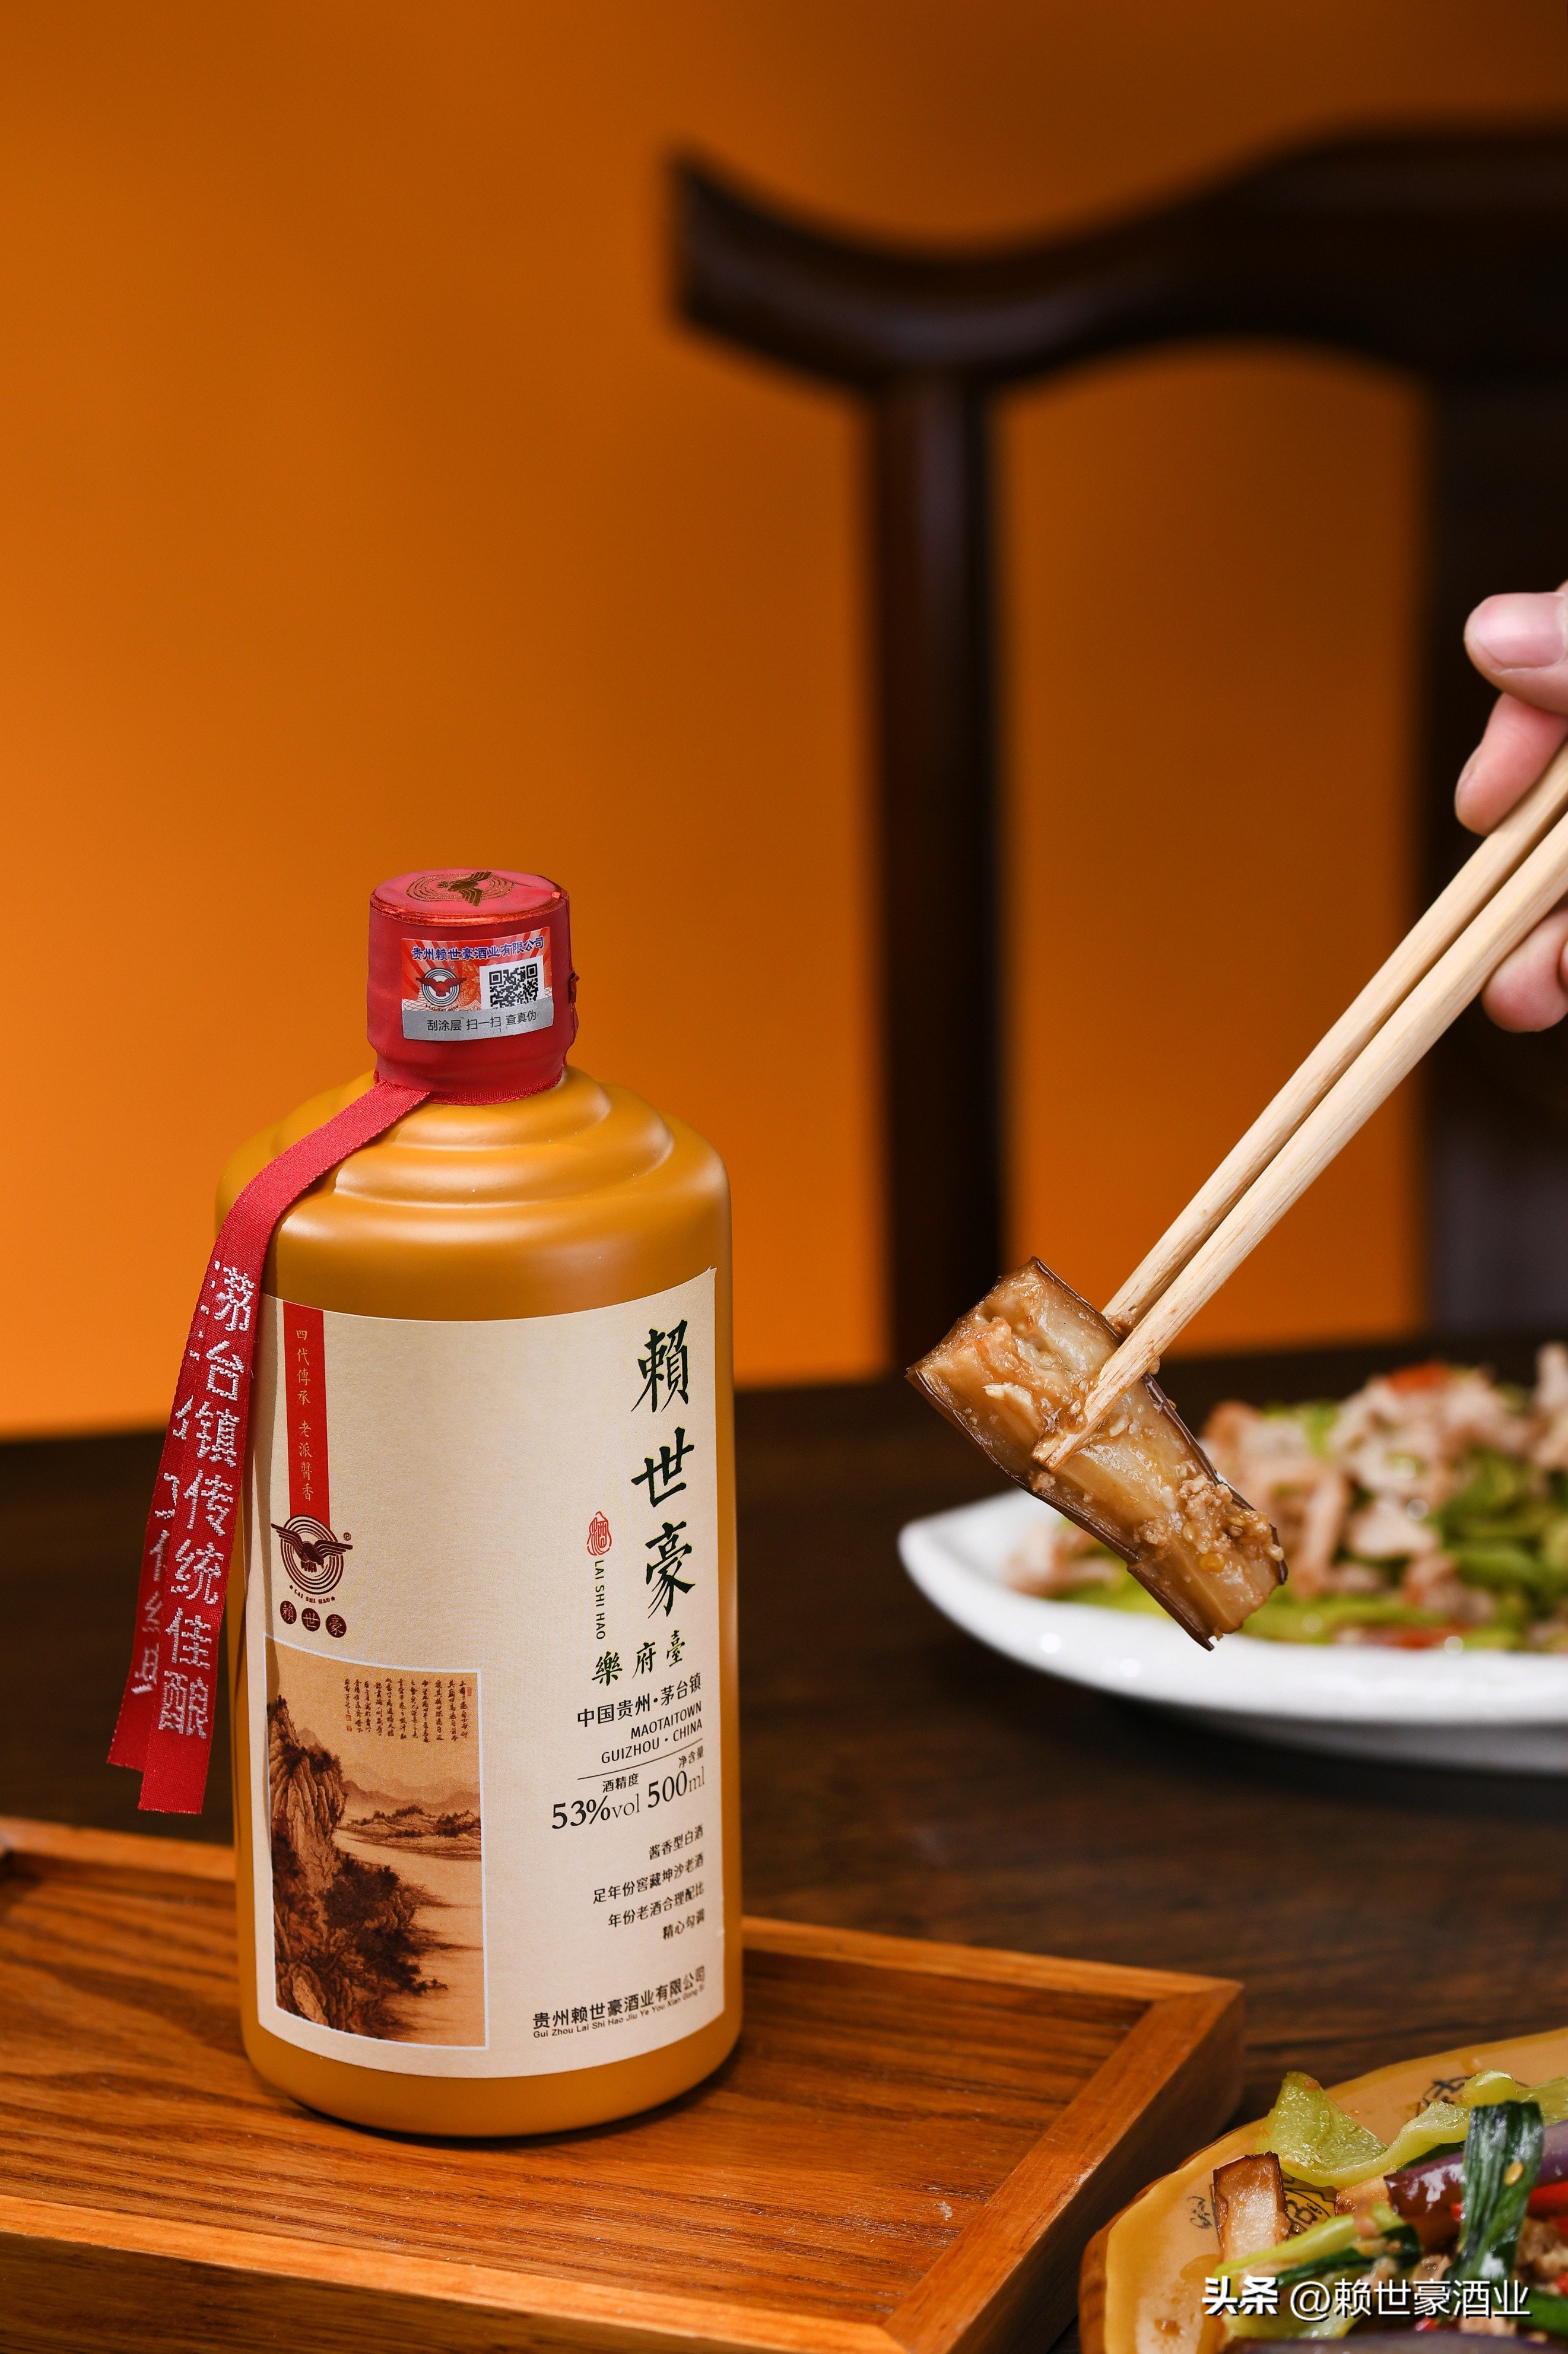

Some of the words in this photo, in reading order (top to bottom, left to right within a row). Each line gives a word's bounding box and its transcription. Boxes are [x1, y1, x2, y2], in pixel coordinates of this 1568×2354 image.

[412, 936, 544, 961] 贵州赖世豪酒业有限公司
[427, 1019, 462, 1032] 刮涂层
[466, 1016, 501, 1030] 扫一扫
[506, 1010, 537, 1026] 查真伪
[296, 1330, 311, 1406] 四代傳承
[595, 1560, 604, 1579] LAI
[595, 1585, 605, 1607] SHI
[596, 1613, 605, 1639] HAO
[630, 1701, 702, 1740] MAOTAITOWN
[601, 1737, 660, 1764] GUIZHOU
[672, 1718, 703, 1742] CHINA
[678, 1746, 704, 1769] 净含量
[602, 1773, 639, 1793] 酒精度
[647, 1766, 706, 1809] 500ml
[649, 1824, 704, 1860] 酱香型白酒
[593, 1852, 704, 1904] 足年份窖藏坤沙老酒
[608, 1882, 704, 1928] 年份老酒合理配比
[533, 1965, 705, 2029] 贵州赖世豪酒业有限公司
[551, 2028, 573, 2036] Zhou
[576, 2024, 589, 2033] Lai
[592, 2020, 605, 2029] Shi
[608, 2017, 624, 2026] Hao
